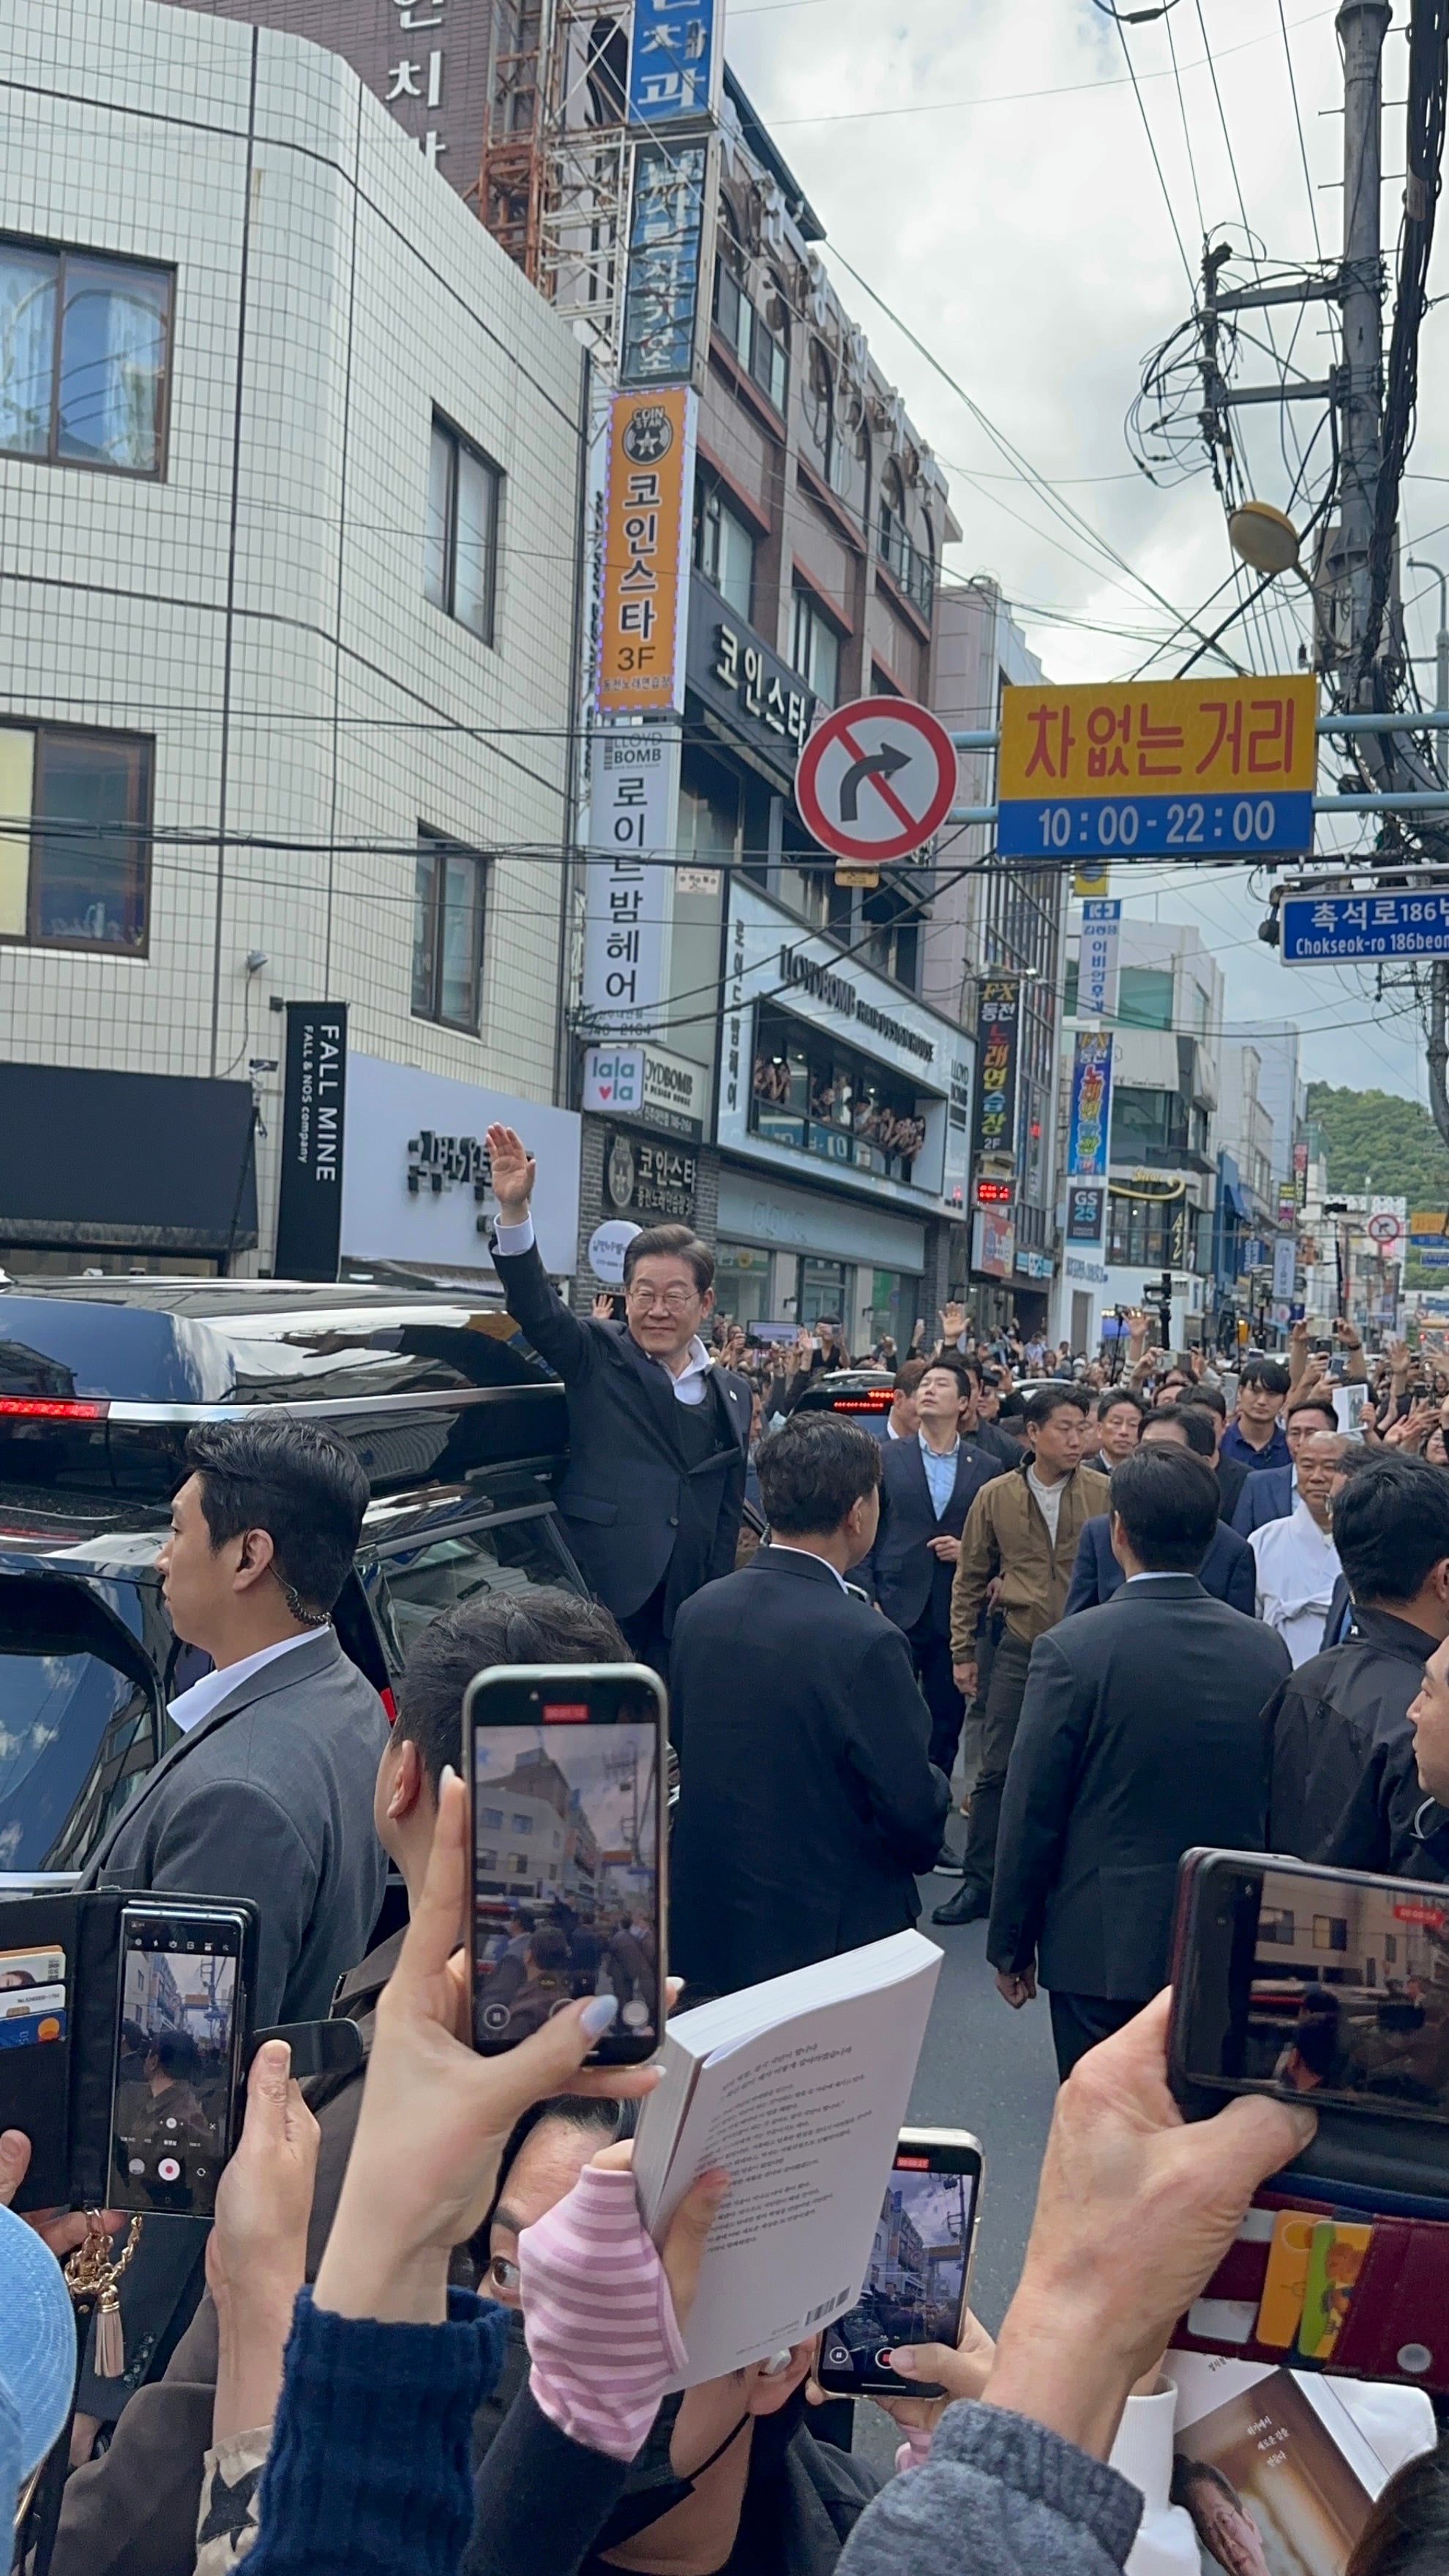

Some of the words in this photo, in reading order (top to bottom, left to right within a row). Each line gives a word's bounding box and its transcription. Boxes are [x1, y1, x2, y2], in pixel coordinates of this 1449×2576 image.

[633, 407, 664, 421] COIN
[635, 419, 662, 430] STAR
[620, 476, 660, 640] 코인스타
[617, 645, 656, 671] 3F
[716, 624, 806, 757] 코인스타
[615, 732, 662, 749] LLOYD
[614, 748, 662, 764] BOMB
[605, 777, 648, 1004] 로이드밤헤어
[1295, 935, 1386, 955] Chokseok-ro
[981, 982, 1016, 1002] FX
[981, 1002, 1016, 1022] 동전
[302, 1025, 314, 1058] FALL
[302, 1060, 313, 1071] &
[318, 1025, 340, 1096] FALL
[593, 1056, 634, 1079] lala
[644, 1057, 693, 1096] OYDBOMB
[981, 1023, 1011, 1136] 노래연습장
[301, 1074, 313, 1103] NOS
[613, 1079, 634, 1101] la
[297, 1107, 310, 1164] company
[315, 1107, 338, 1181] MINE
[984, 1137, 1002, 1150] 2F
[638, 1145, 697, 1194] 코인스타
[1074, 1191, 1097, 1206] GS
[1074, 1206, 1096, 1221] 25
